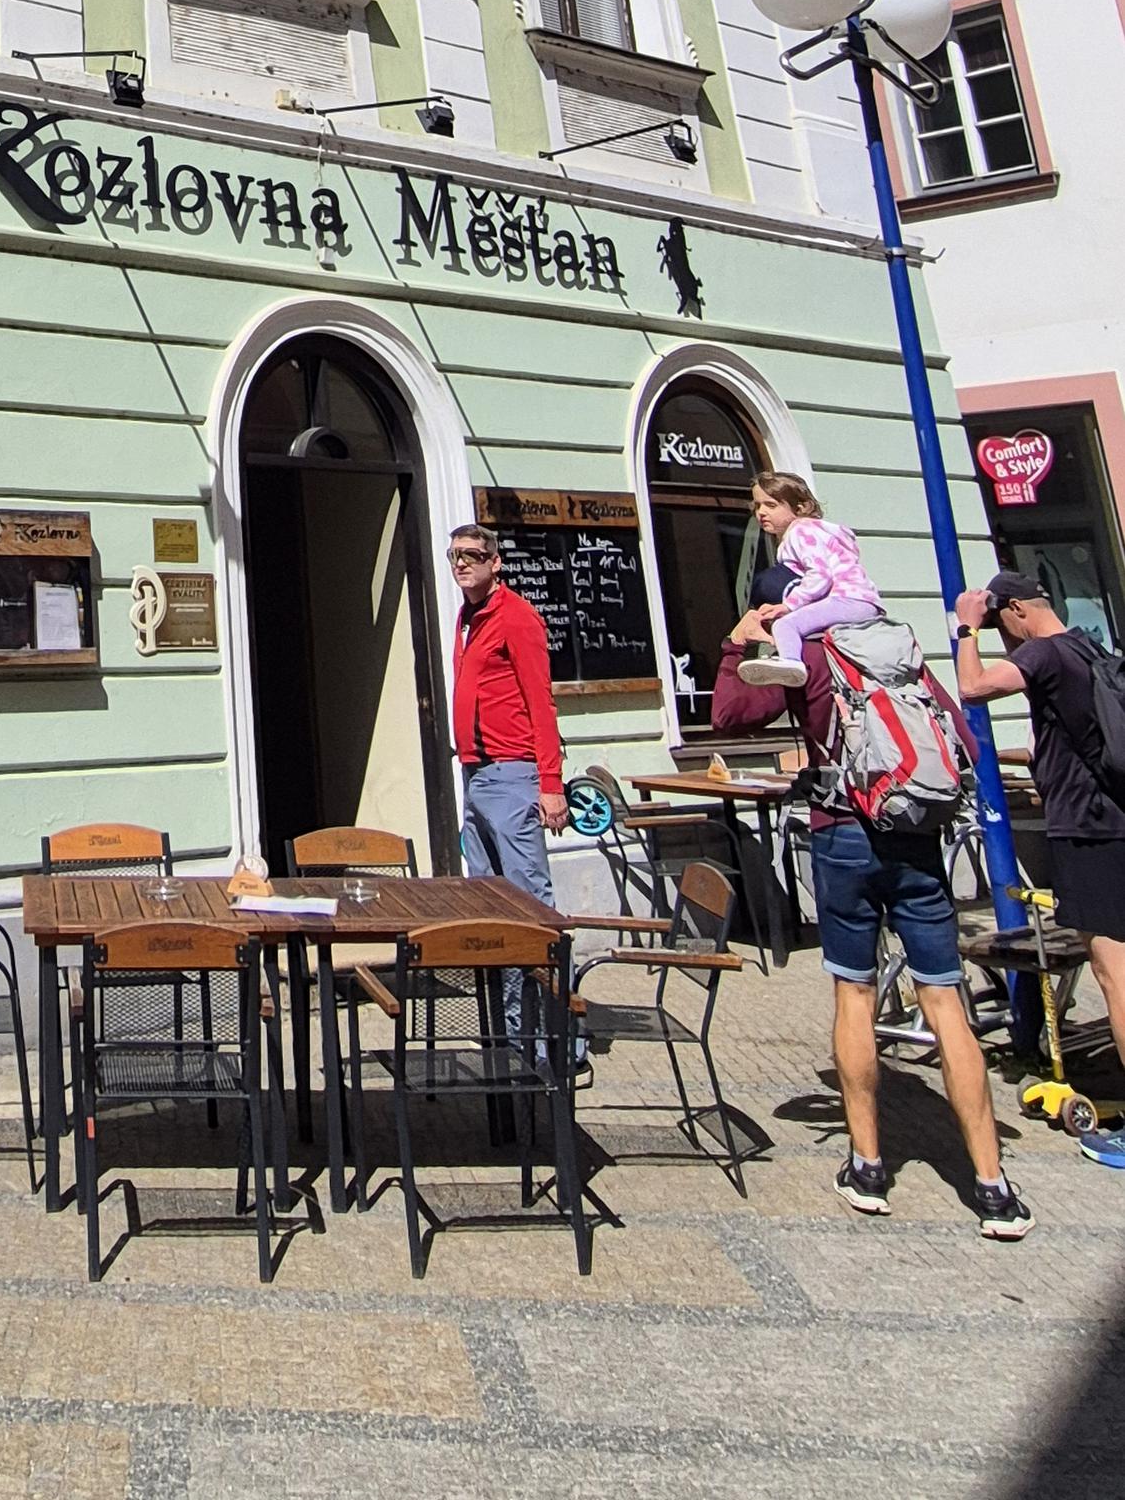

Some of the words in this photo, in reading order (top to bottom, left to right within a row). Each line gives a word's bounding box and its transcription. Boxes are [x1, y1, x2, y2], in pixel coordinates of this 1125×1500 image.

[391, 165, 625, 277] Měšťan
[657, 432, 743, 467] Kozlovna
[986, 436, 1045, 463] Comfort
[994, 464, 1008, 478] &
[1009, 455, 1044, 476] Style
[999, 482, 1021, 496] 150
